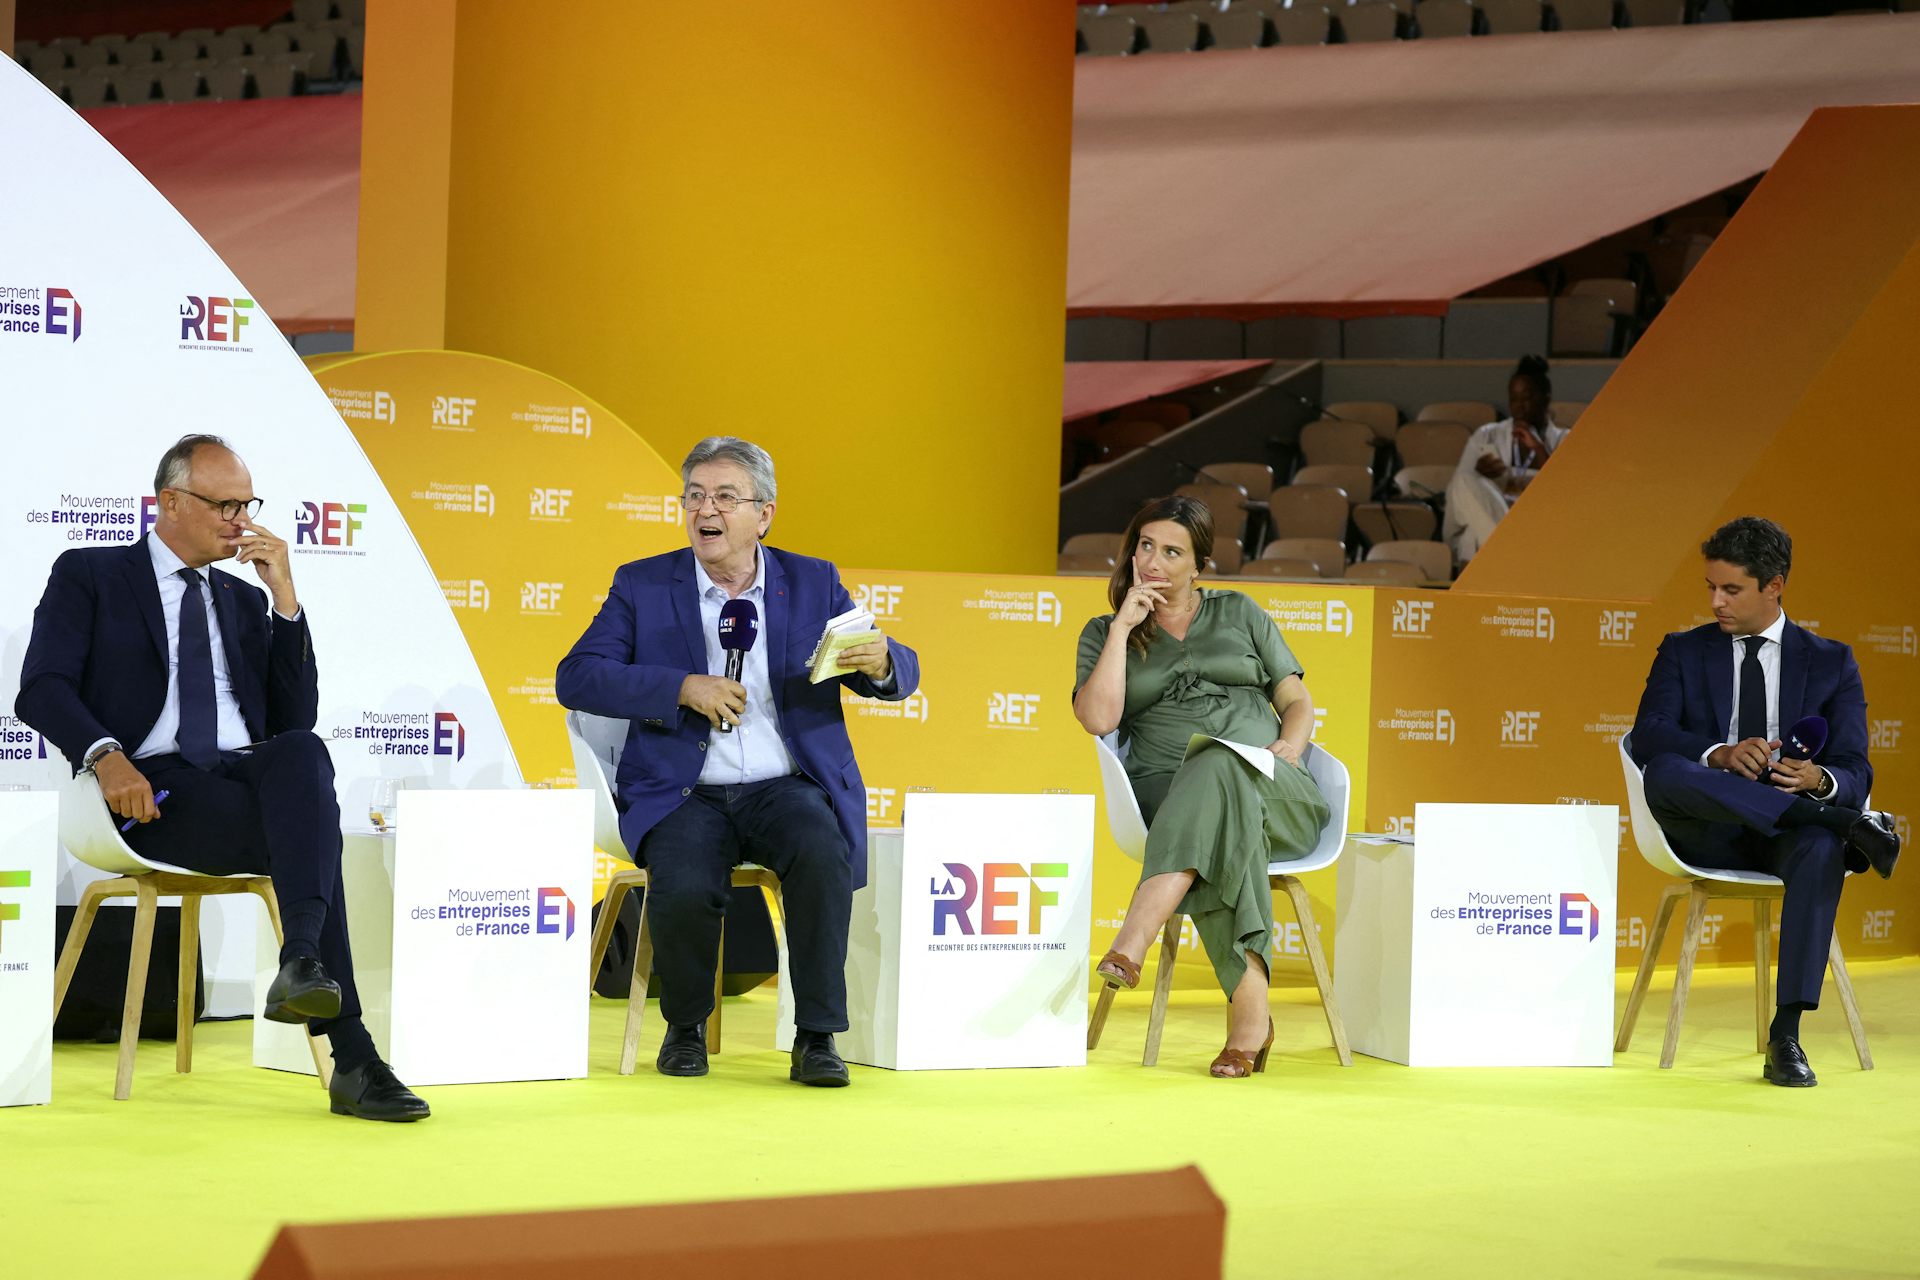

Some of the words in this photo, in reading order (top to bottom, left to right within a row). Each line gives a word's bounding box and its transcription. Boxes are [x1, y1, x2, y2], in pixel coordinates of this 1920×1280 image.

[0, 286, 40, 300] ement
[179, 304, 194, 315] LA
[181, 295, 254, 342] REF
[432, 396, 477, 426] REF
[60, 494, 135, 508] Mouvement
[530, 487, 573, 517] REF
[26, 509, 49, 523] des
[51, 509, 135, 527] Entreprises
[295, 509, 309, 521] LA
[296, 501, 368, 547] REF
[67, 527, 83, 541] de
[85, 528, 135, 541] France
[521, 582, 564, 610] REF
[855, 583, 904, 615] REF
[984, 589, 1034, 600] Mouvement
[979, 599, 1034, 610] Entreprises
[1268, 598, 1323, 609] Mouvement
[1000, 611, 1034, 622] France
[1393, 599, 1434, 632] REF
[1286, 621, 1322, 632] France
[1600, 610, 1637, 641] REF
[988, 692, 1041, 725] REF
[1395, 707, 1434, 718] Mouvement
[362, 711, 429, 724] Mouvement
[1378, 719, 1390, 729] des
[1390, 719, 1434, 730] Entreprises
[332, 726, 353, 739] des
[354, 725, 429, 741] Entreprises
[1501, 710, 1541, 742] REF
[1870, 719, 1903, 748] REF
[1398, 731, 1408, 741] de
[1408, 731, 1434, 741] France
[368, 742, 383, 755] de
[385, 743, 429, 755] France
[866, 787, 896, 818] EF
[930, 877, 956, 895] LA
[448, 887, 531, 902] Mouvement
[932, 862, 1069, 936] REF
[1468, 892, 1553, 905] Mouvement
[411, 906, 436, 920] des
[438, 902, 531, 921] Entreprises
[1430, 906, 1456, 919] des
[1458, 906, 1553, 922] Entreprises
[456, 922, 473, 937] de
[476, 922, 530, 936] France
[1476, 922, 1494, 935] de
[1496, 923, 1553, 935] France
[1862, 910, 1895, 938] REF
[928, 943, 964, 952] RENCONTRE
[966, 943, 978, 951] DES
[980, 943, 1031, 951] ENTREPRENEURS
[1043, 942, 1066, 950] FRANCE
[4, 963, 29, 971] FRANCE
